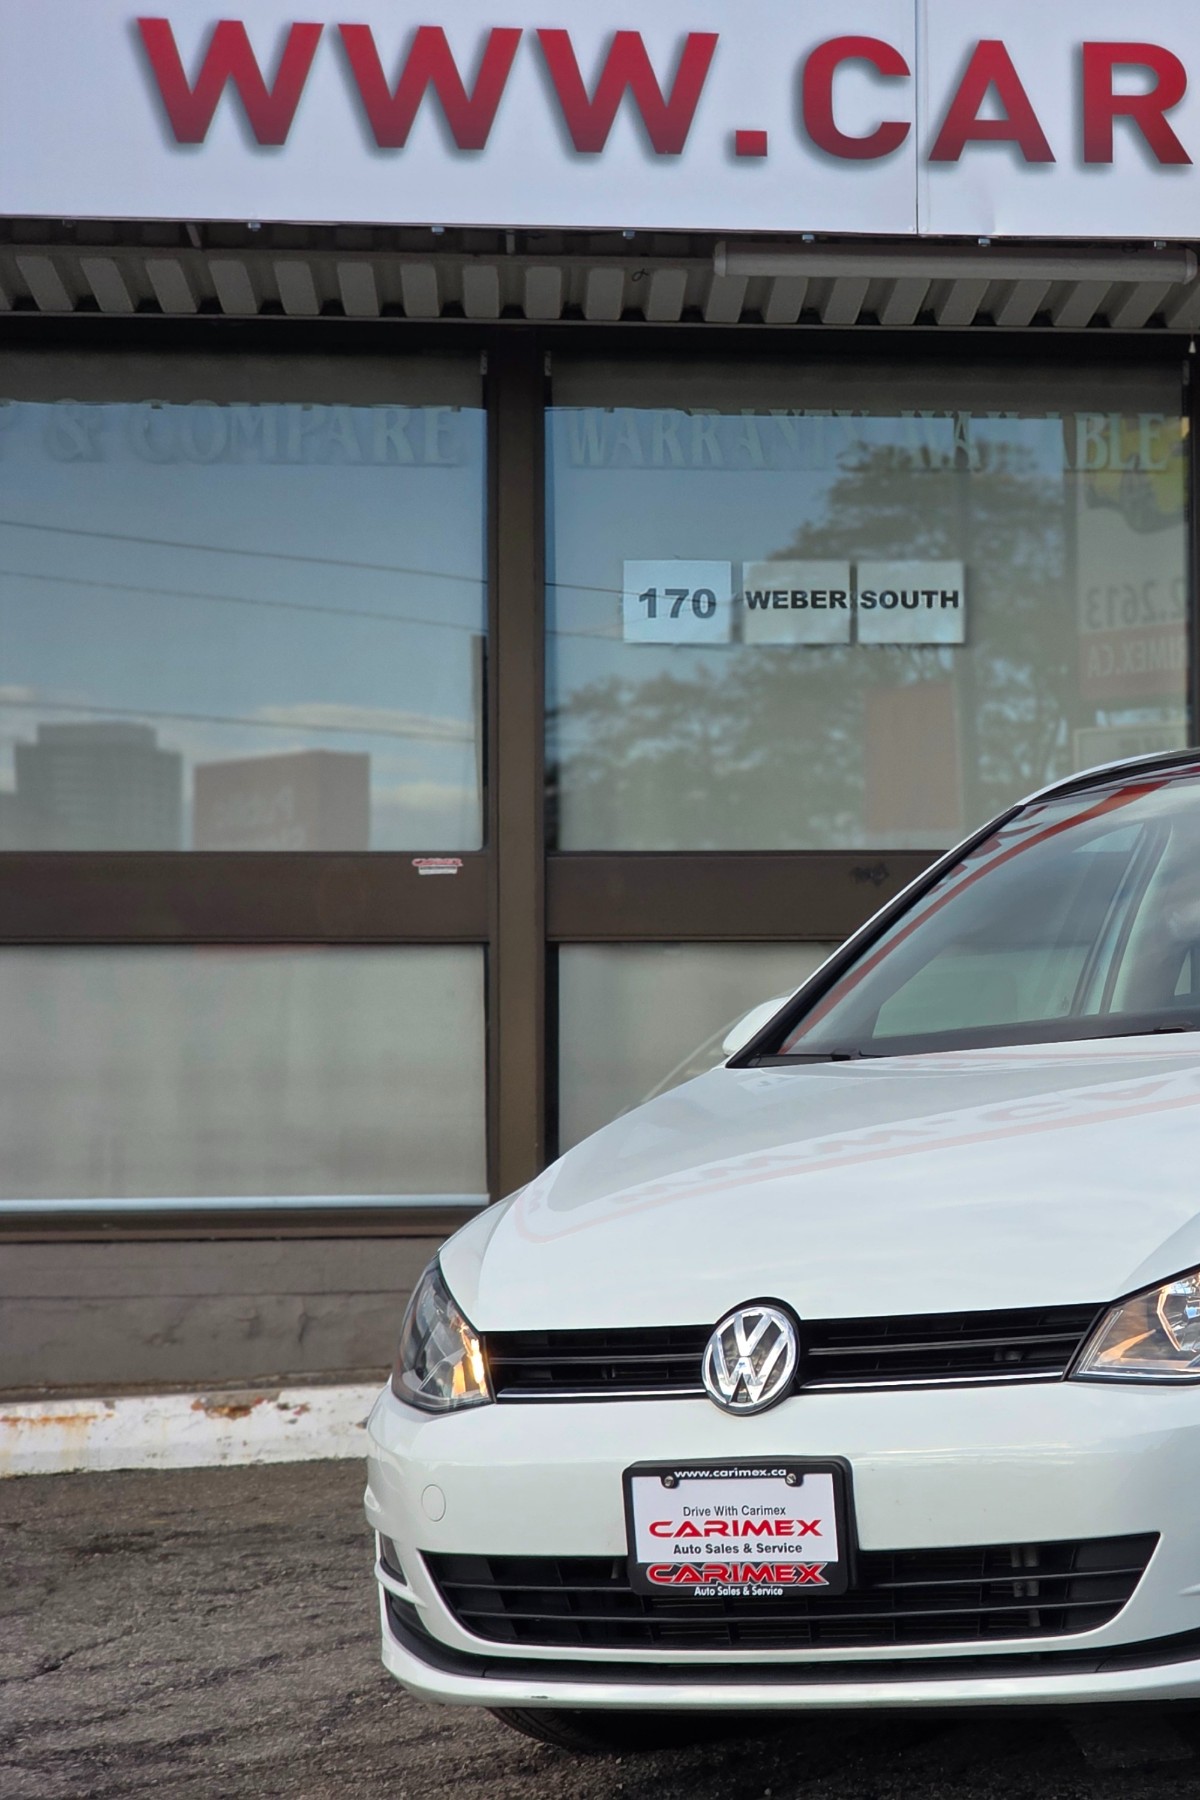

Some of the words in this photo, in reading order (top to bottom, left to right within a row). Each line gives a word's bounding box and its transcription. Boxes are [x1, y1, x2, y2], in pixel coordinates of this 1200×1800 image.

[130, 399, 461, 466] COMPARE
[637, 588, 718, 620] 170
[745, 590, 848, 610] WEBER
[859, 589, 960, 610] SOUTH
[674, 1467, 787, 1479] www.carimex.ca
[683, 1506, 711, 1517] Drive
[714, 1505, 738, 1517] With
[741, 1505, 786, 1516] Carimex
[649, 1519, 823, 1538] CARIMEX
[673, 1543, 702, 1555] Auto
[705, 1543, 739, 1555] Sales
[743, 1543, 753, 1554] &
[756, 1543, 803, 1554] Service
[648, 1563, 824, 1584] CARIMEX
[694, 1586, 716, 1597] Auto
[717, 1586, 741, 1597] Sales
[743, 1586, 750, 1596] &
[751, 1586, 783, 1597] Service
